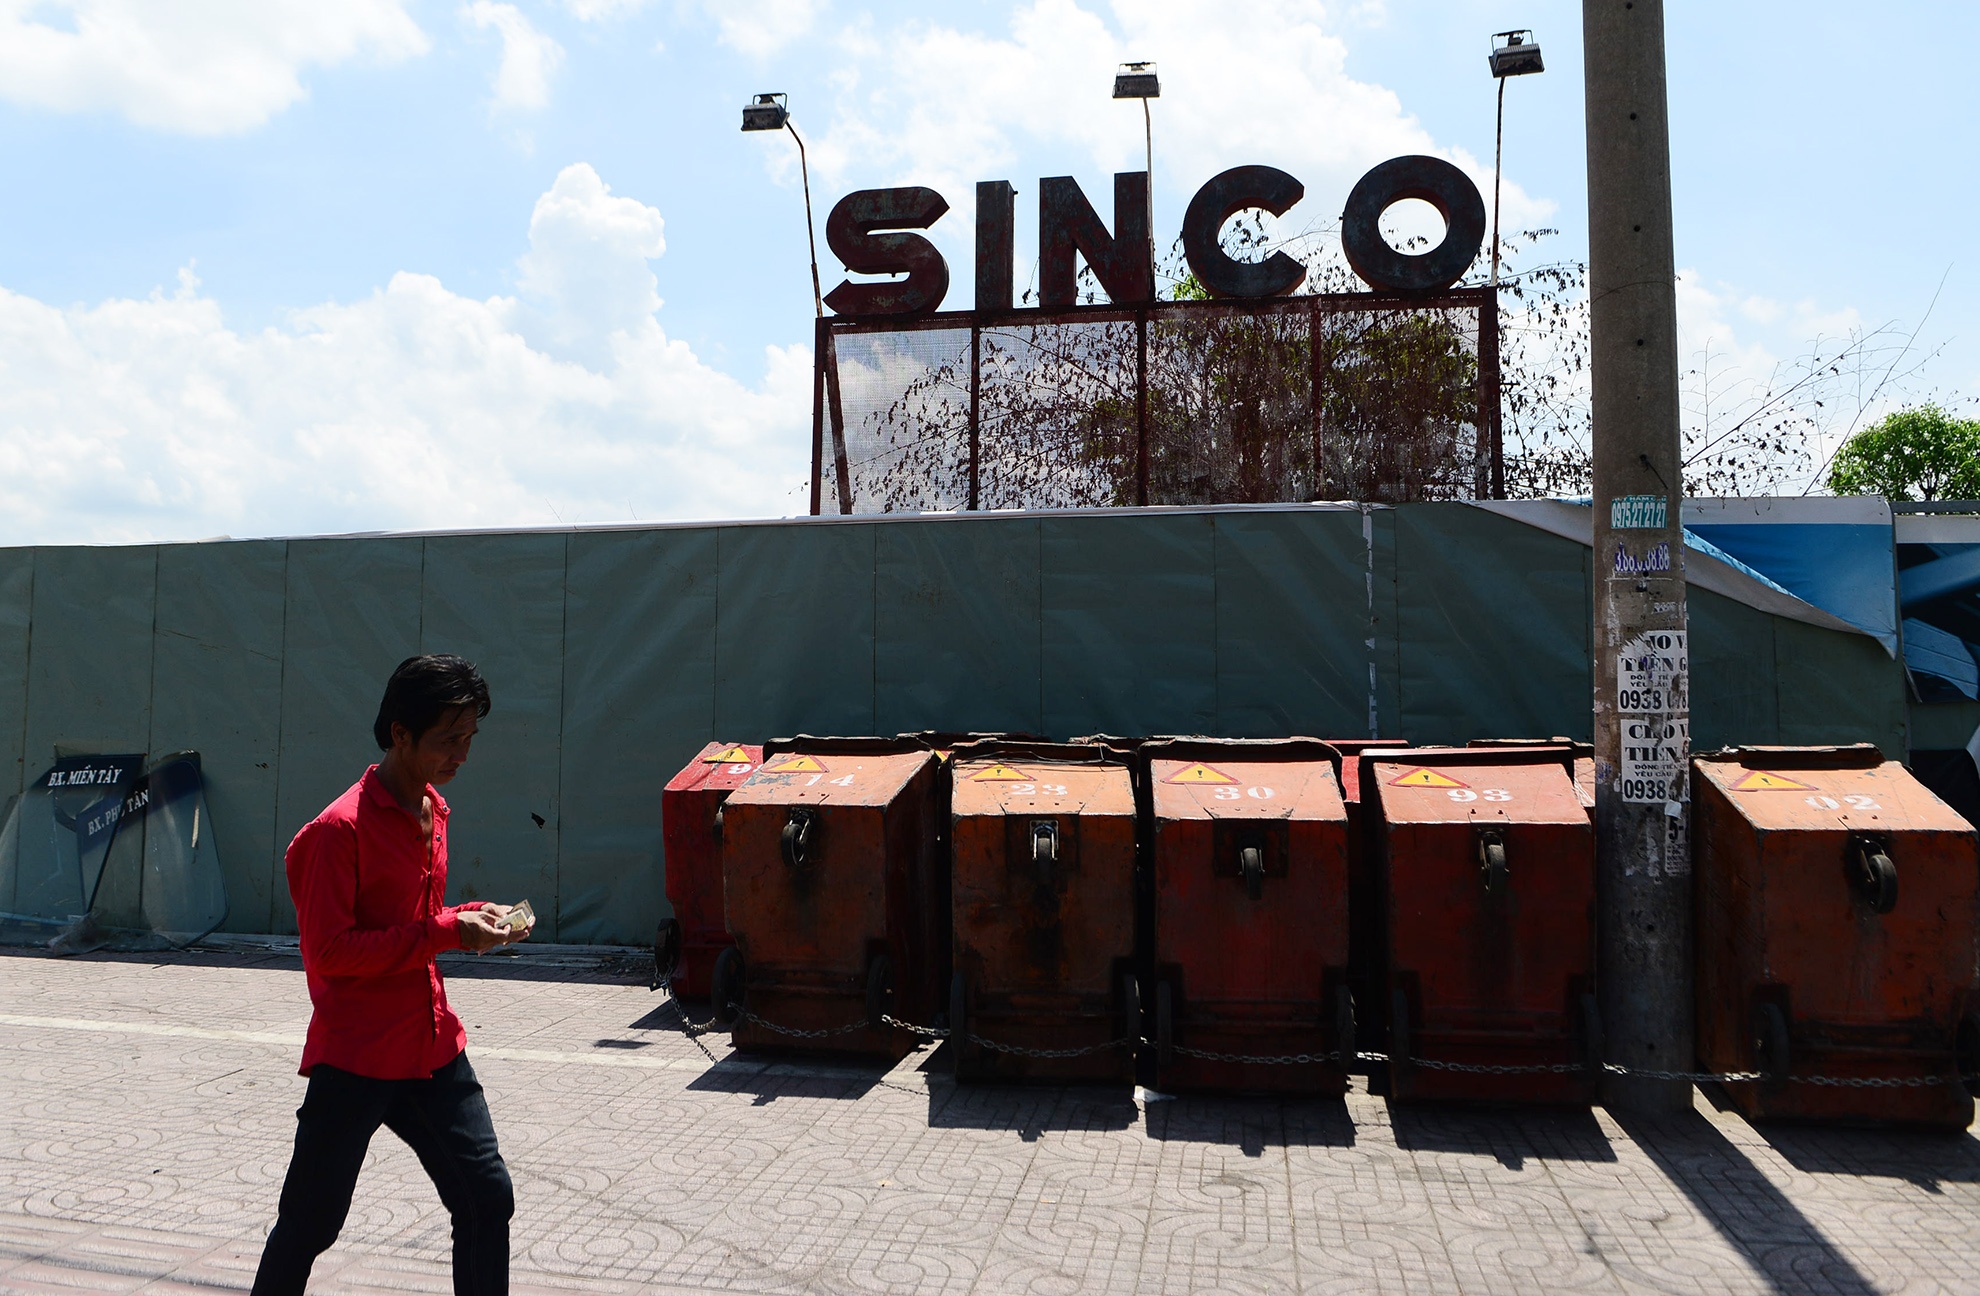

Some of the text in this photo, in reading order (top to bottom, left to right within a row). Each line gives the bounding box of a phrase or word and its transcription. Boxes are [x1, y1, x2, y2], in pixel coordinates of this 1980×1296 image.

[824, 155, 1486, 313] SINCO
[1620, 690, 1662, 710] 0938
[67, 764, 97, 785] MIỀN
[97, 764, 122, 784] TÂY
[727, 763, 764, 775] 9
[805, 774, 854, 787] 14
[1011, 783, 1068, 796] 23
[1214, 786, 1276, 800] 30
[1446, 788, 1514, 802] 93
[1624, 779, 1667, 800] 0938
[126, 789, 149, 813] TÂN
[1804, 795, 1882, 810] 02
